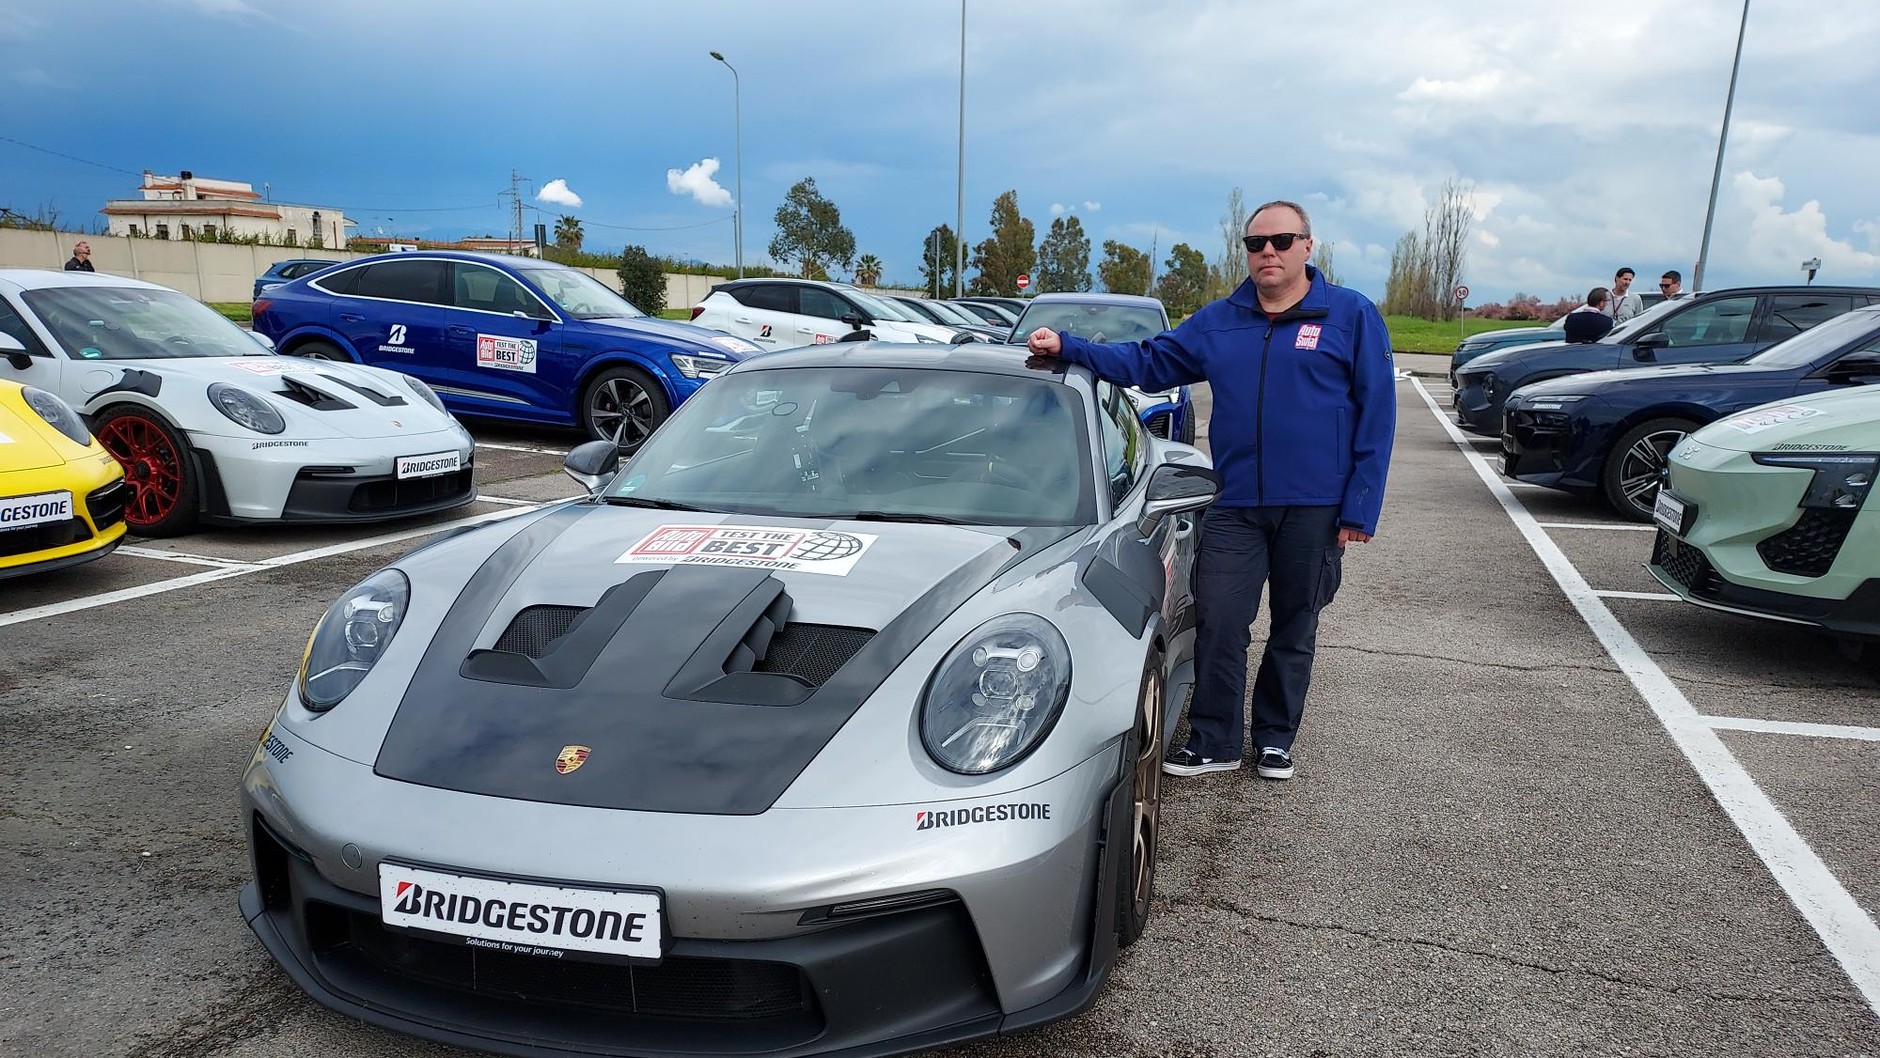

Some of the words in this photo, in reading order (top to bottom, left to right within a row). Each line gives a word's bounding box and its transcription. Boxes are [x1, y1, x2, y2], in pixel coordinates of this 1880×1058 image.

[1297, 324, 1322, 337] Auto
[378, 345, 416, 355] BRIDGESTONE
[496, 350, 516, 362] BEST
[251, 441, 310, 451] BRIDGESTONE
[1771, 443, 1850, 451] BRIDGESTONE
[401, 456, 458, 474] BRIDGESTONE
[0, 500, 68, 522] GESTONE
[720, 531, 760, 539] TEST
[762, 533, 795, 541] THE
[700, 540, 785, 556] BEST
[680, 556, 802, 569] BRIDGESTONE
[916, 803, 1051, 831] BRIDGESTONE
[393, 880, 647, 942] BRIDGESTONE
[465, 937, 500, 949] Solutions
[501, 942, 513, 951] for
[513, 945, 532, 953] your
[532, 946, 564, 959] journey
